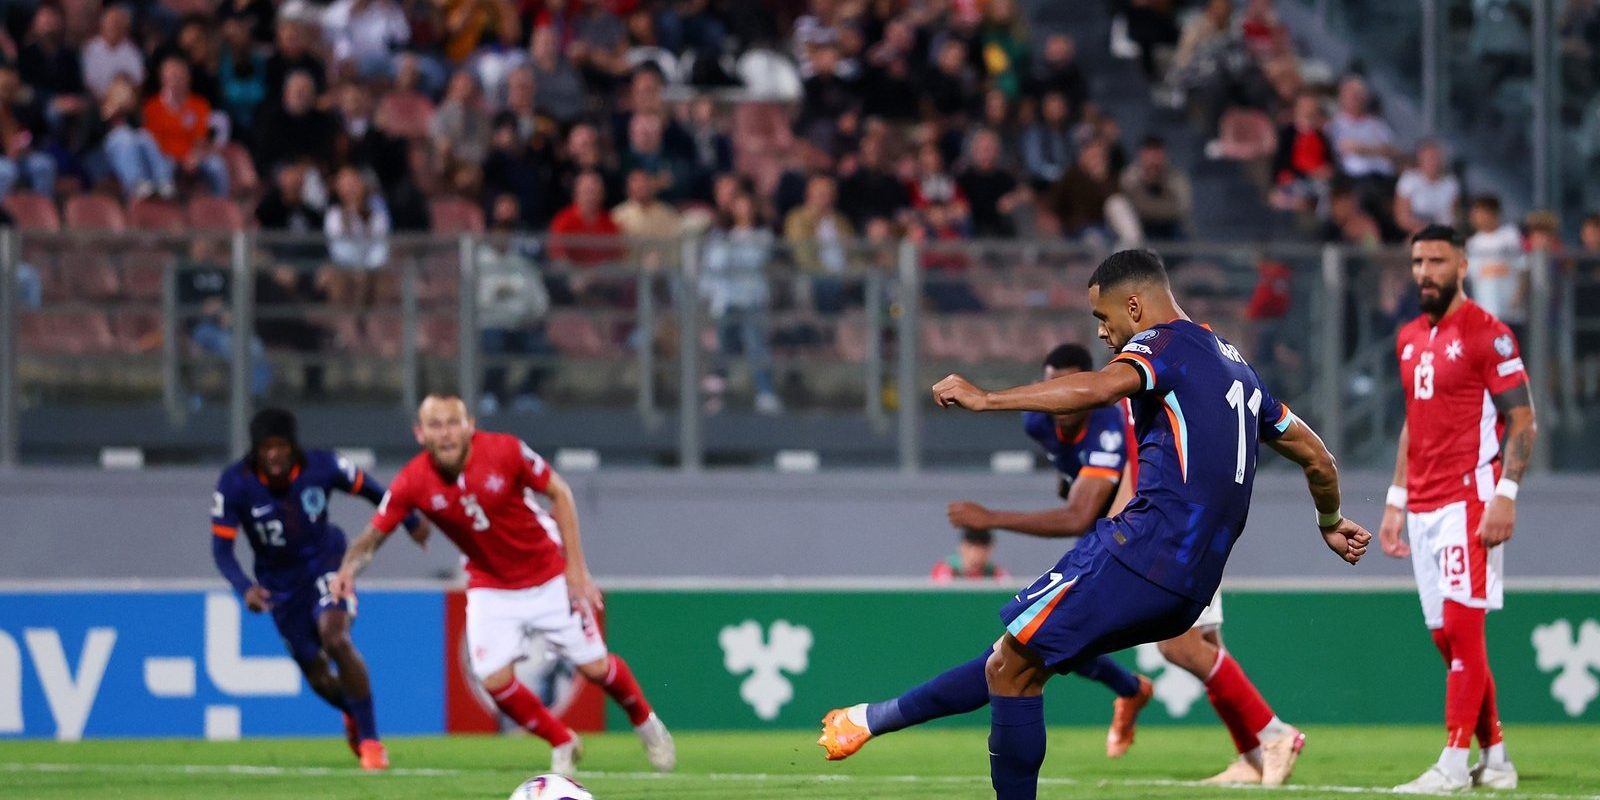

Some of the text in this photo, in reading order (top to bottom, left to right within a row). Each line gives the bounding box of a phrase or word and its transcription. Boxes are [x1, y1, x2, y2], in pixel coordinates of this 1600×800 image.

[1414, 363, 1434, 400] 13
[464, 502, 491, 531] 3
[255, 519, 287, 546] 12
[1444, 545, 1466, 577] 13
